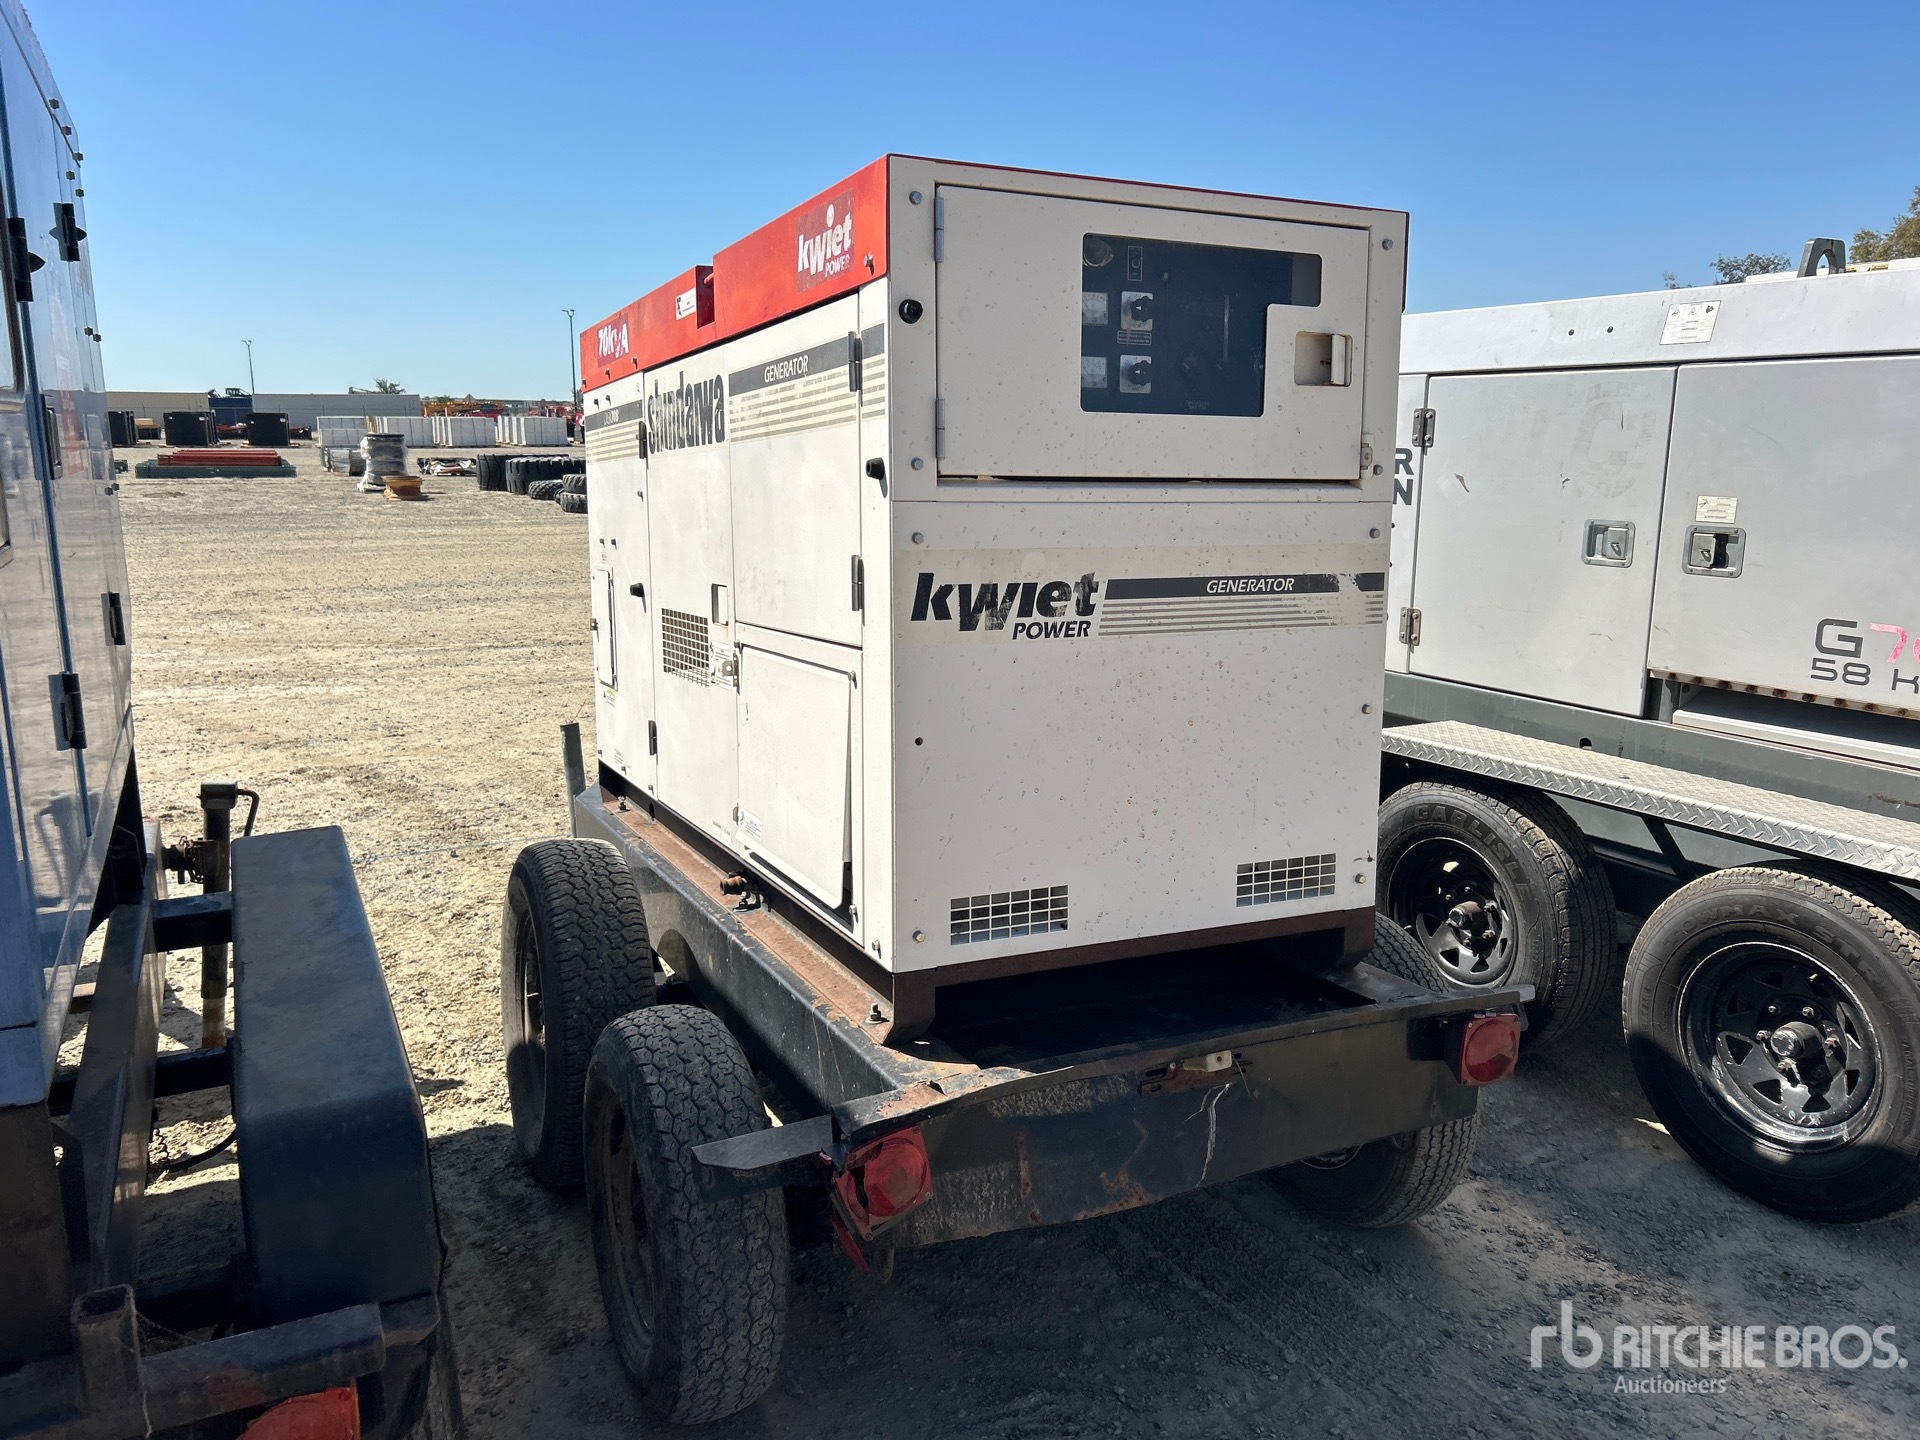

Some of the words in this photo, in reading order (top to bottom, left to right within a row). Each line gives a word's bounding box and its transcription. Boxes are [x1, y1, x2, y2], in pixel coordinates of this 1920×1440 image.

[797, 204, 852, 275] kwiet
[825, 256, 850, 277] POWER
[764, 354, 809, 383] GENERATOR
[1205, 576, 1295, 594] GENERATOR
[910, 572, 1099, 632] kwiet
[1013, 620, 1091, 640] POWER
[1815, 618, 1920, 665] G7
[1810, 657, 1872, 686] 58
[1414, 805, 1534, 902] CARLISLE
